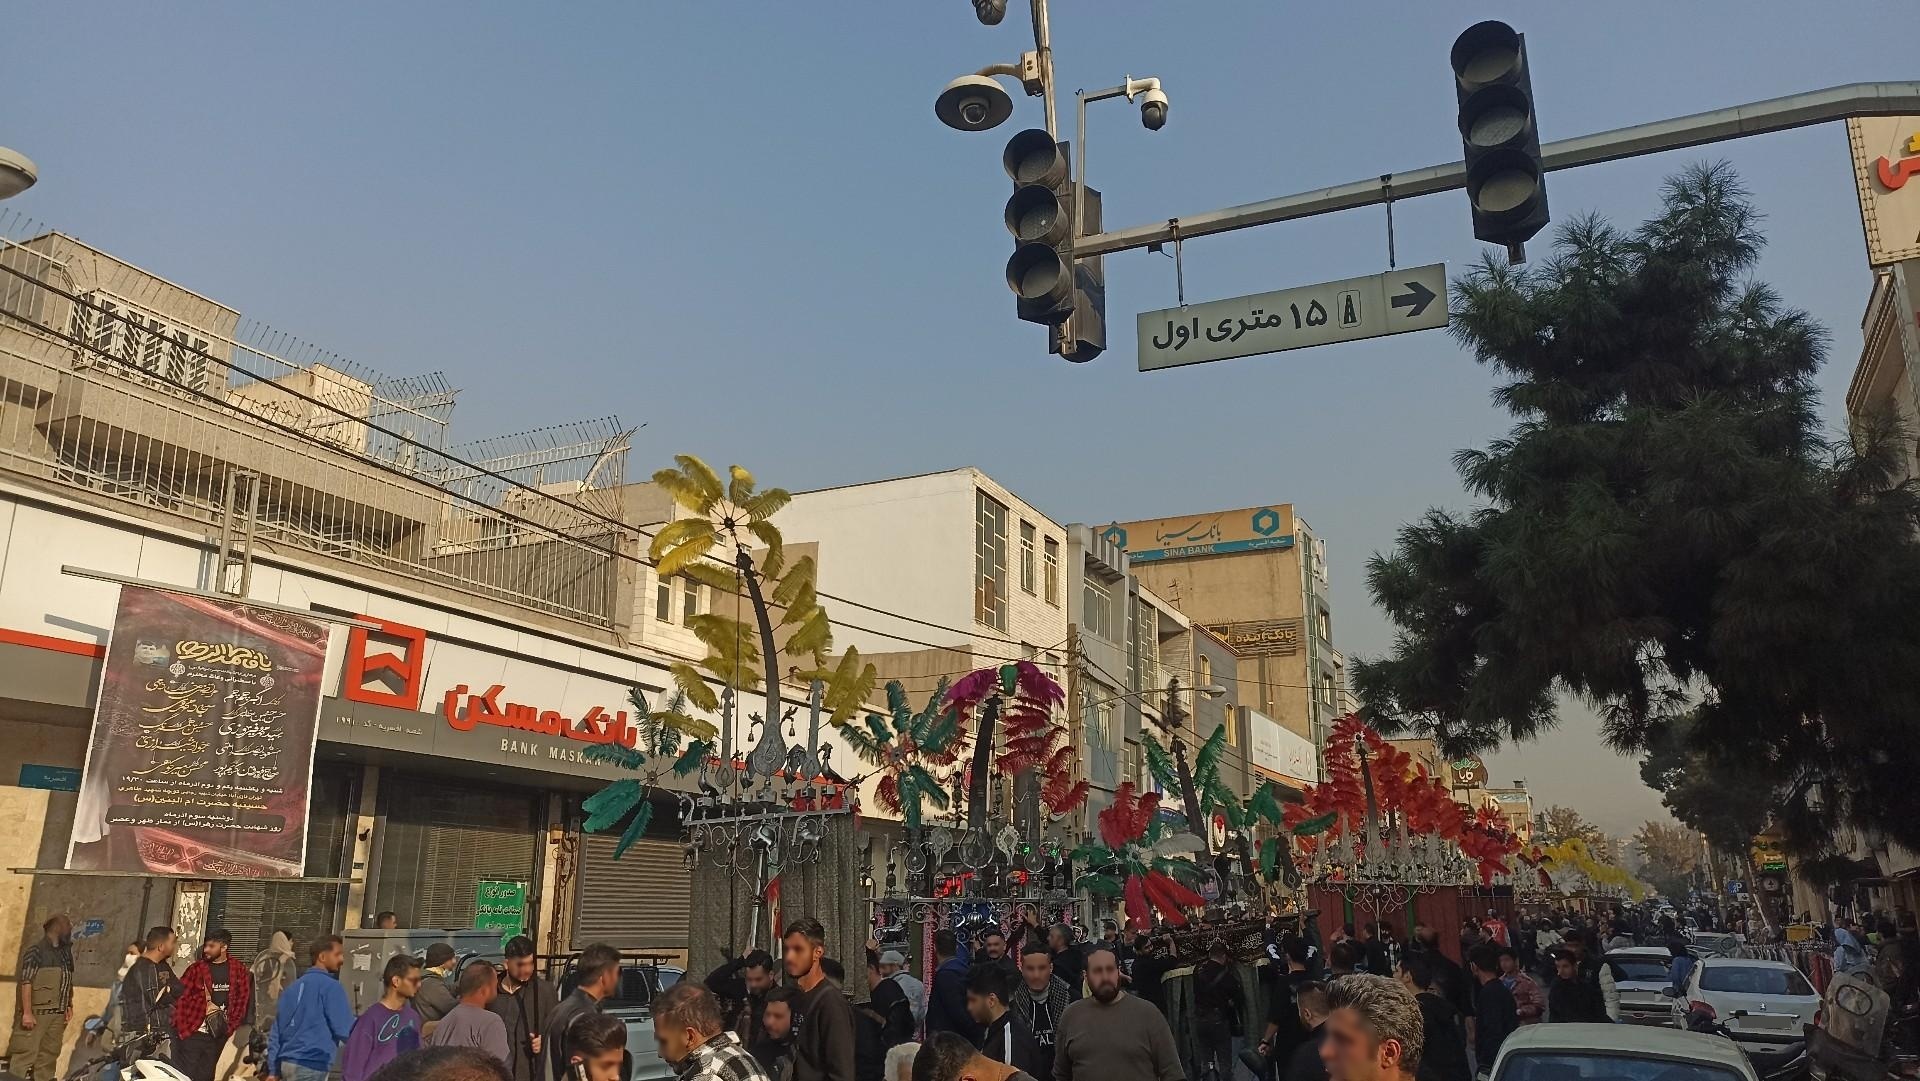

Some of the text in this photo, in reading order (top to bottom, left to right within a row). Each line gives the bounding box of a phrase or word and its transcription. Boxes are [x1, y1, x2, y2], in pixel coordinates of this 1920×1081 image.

[1152, 299, 1328, 351] ۱۵ متری اول
[1156, 512, 1224, 546] بانک سینا
[1163, 544, 1215, 558] SINA BANK
[1236, 628, 1293, 643] بانک آینده
[444, 684, 637, 749] بانک مسکن
[500, 738, 538, 756] BANK
[196, 799, 230, 808] حضرت
[232, 801, 268, 810] حسینیه
[484, 886, 517, 899] صدور انواع
